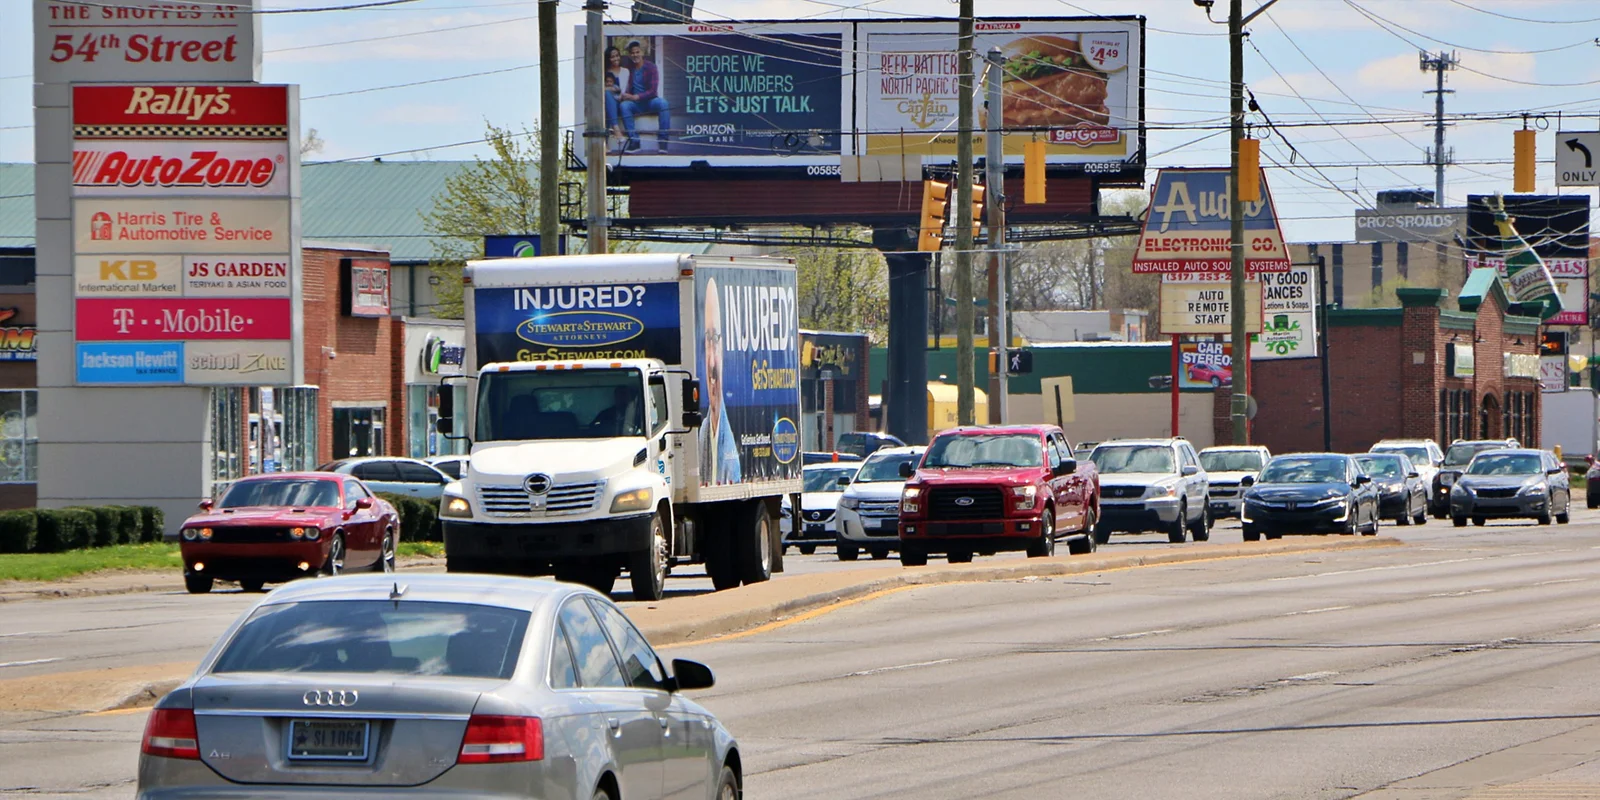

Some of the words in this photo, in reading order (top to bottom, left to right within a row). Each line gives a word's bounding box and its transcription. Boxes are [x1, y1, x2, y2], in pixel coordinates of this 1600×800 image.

[49, 5, 90, 20] THE
[102, 5, 201, 20] SHOPPES
[212, 5, 238, 20] AT
[50, 32, 120, 63] 54th
[124, 33, 238, 63] Street
[686, 55, 739, 73] BEFORE
[742, 55, 765, 73] WE
[686, 75, 720, 93] TALK
[723, 75, 794, 93] NUMBERS
[880, 77, 912, 95] NORTH
[915, 77, 951, 95] PACIFIC
[124, 86, 231, 120] Rally's
[686, 95, 728, 114] LET'S
[731, 95, 770, 113] JUST
[772, 94, 815, 112] TALK.
[686, 124, 735, 135] HORIZON
[94, 150, 275, 188] AutoZone
[1562, 171, 1597, 182] ONLY
[1154, 175, 1266, 233] Audo
[117, 211, 166, 226] Harris
[173, 211, 203, 226] Tire
[210, 211, 221, 226] &
[1357, 215, 1452, 228] CROSSROADS
[118, 226, 208, 241] Automotive
[215, 226, 272, 241] Service
[1251, 237, 1277, 252] CO.
[100, 260, 158, 281] KB
[189, 262, 209, 278] JS
[215, 262, 287, 278] GARDEN
[1134, 261, 1180, 272] INSTALLED
[1184, 262, 1208, 272] AUTO
[1250, 261, 1288, 271] SYSTEMS
[189, 280, 225, 289] TERIYAKI
[264, 280, 287, 288] FOOD
[1277, 271, 1308, 285] GOOD
[78, 282, 140, 293] International
[142, 282, 177, 293] Market
[514, 285, 646, 311] INJURED?
[1198, 291, 1224, 301] AUTO
[1188, 303, 1229, 312] REMOTE
[1286, 301, 1290, 309] &
[724, 285, 795, 351] INJURED?
[1195, 315, 1225, 324] START
[552, 333, 607, 341] ATTORNEYS
[1198, 342, 1223, 354] CAR
[82, 351, 134, 369] Jackson
[135, 350, 178, 368] Hewitt
